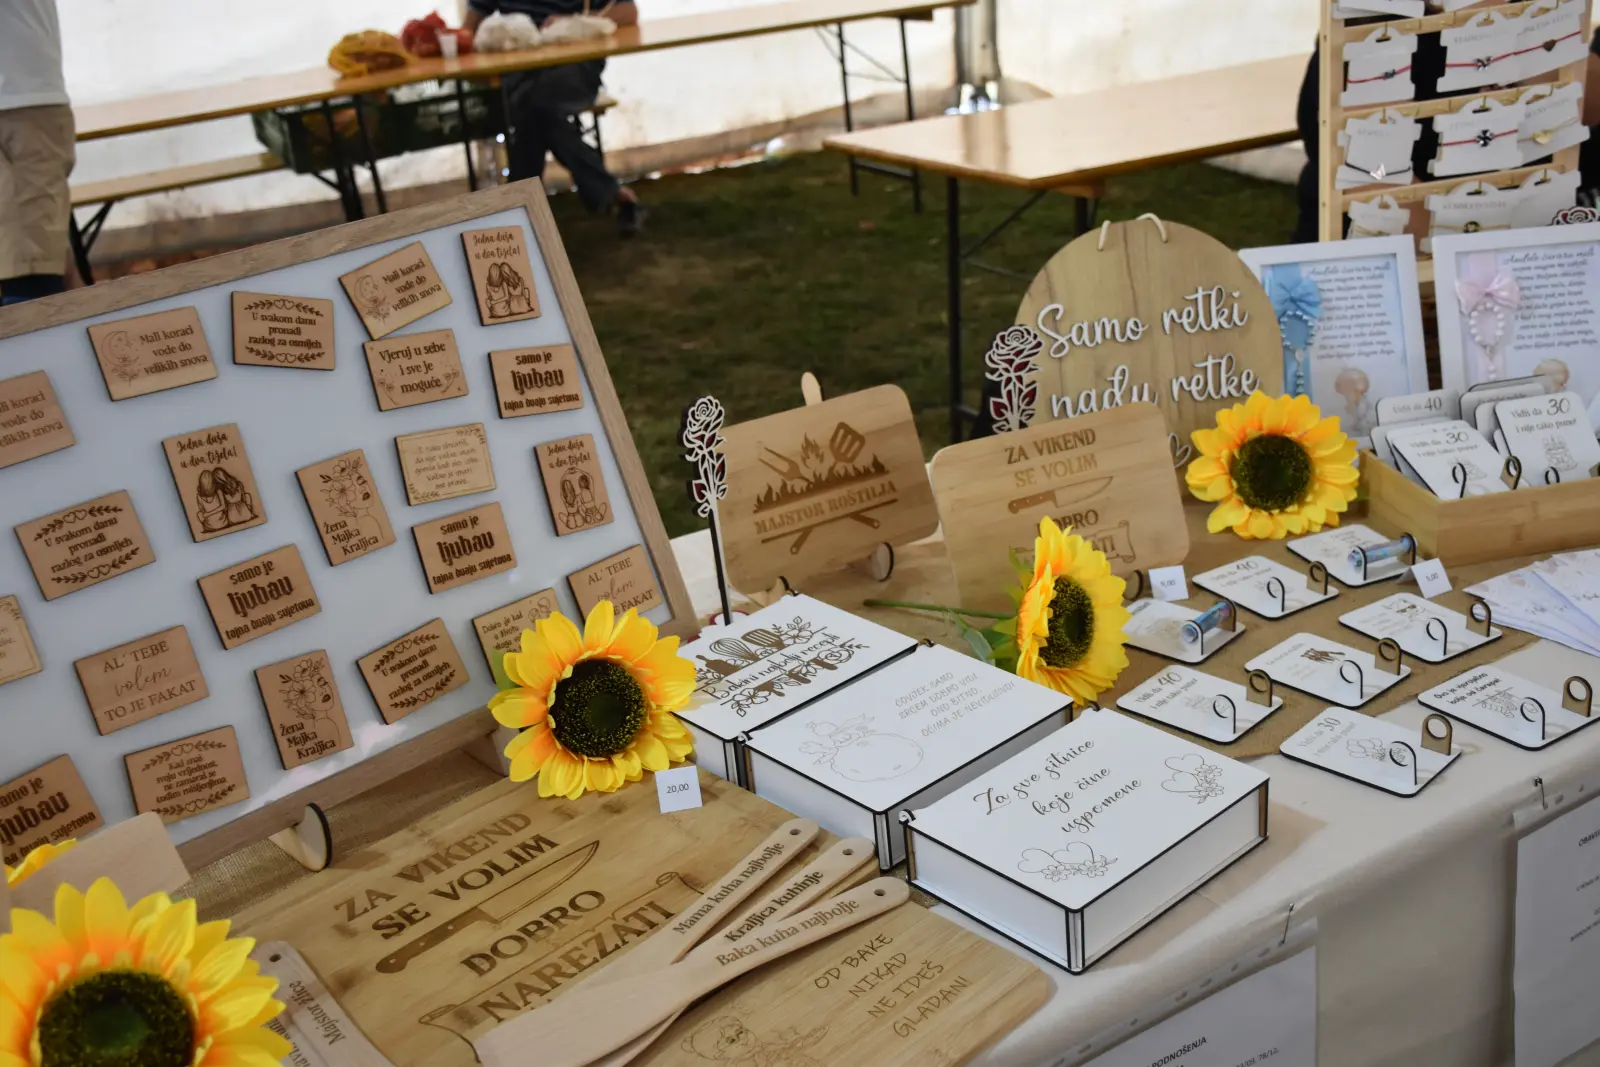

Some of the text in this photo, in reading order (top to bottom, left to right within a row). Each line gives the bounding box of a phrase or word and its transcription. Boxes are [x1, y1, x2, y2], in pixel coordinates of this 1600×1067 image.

[473, 231, 515, 246] Jedna duša
[383, 258, 426, 284] Mali koraci
[395, 274, 427, 295] vode do
[392, 283, 442, 313] velikih snova
[252, 312, 316, 326] U svakom danu
[1038, 303, 1149, 358] Samo
[1162, 285, 1248, 335] retki
[139, 325, 194, 345] Mali koraci
[248, 336, 275, 347] razlog
[288, 339, 322, 350] osmijeh
[152, 341, 191, 357] vode do
[379, 341, 446, 363] Vjeruj u sebe
[516, 351, 553, 366] samo je
[144, 354, 208, 376] velikih snova
[400, 359, 434, 376] i sve je
[1171, 352, 1260, 402] retke
[400, 377, 443, 395] moguće
[511, 367, 565, 396] ljubav
[11, 391, 45, 409] koraci
[1424, 397, 1442, 410] 40
[1546, 398, 1570, 415] 30
[1, 409, 44, 429] vode do
[32, 421, 63, 437] snova
[176, 432, 228, 453] Jedna duša
[547, 438, 586, 455] Jedna duša
[1005, 428, 1096, 465] ZA VIKEND
[1446, 431, 1469, 444] 30
[1014, 453, 1098, 488] SE VOLIM
[754, 480, 897, 535] MAJSTOR ROŠTILJA
[45, 516, 118, 548] U svakom danu
[324, 518, 347, 535] Žena
[332, 526, 360, 545] Majka
[440, 514, 479, 535] samo je
[51, 537, 133, 574] razlog za osmijeh
[342, 534, 379, 556] Kraljica
[436, 531, 496, 566] ljubav
[229, 559, 275, 585] samo je
[605, 557, 633, 575] TEBE
[1237, 559, 1258, 574] 40
[226, 575, 295, 619] ljubav
[621, 589, 654, 615] FAKAT
[130, 641, 169, 662] TEBE
[381, 643, 437, 678] U svakom danu
[702, 632, 841, 701] Bakini najbolji recepti
[113, 665, 173, 697] volem
[388, 660, 450, 700] razlog za osmijeh
[1158, 669, 1182, 690] 40
[104, 679, 197, 723] TO JE FAKAT
[279, 720, 304, 737] Žena
[1318, 714, 1341, 735] 30
[287, 730, 318, 748] Majka
[297, 738, 336, 760] Kraljica
[28, 775, 45, 792] je
[156, 773, 176, 784] svoju
[666, 782, 689, 794] 20,00
[973, 738, 1095, 816] Za sve sitnice
[1032, 766, 1111, 816] koje čine
[1061, 777, 1142, 833] uspomene
[334, 812, 532, 923] ZA VIKEND
[371, 833, 560, 940] SE VOLIM
[672, 840, 785, 935] Mama kuha najbolje
[724, 869, 824, 942] Kraljica kuhinje
[460, 890, 606, 977] DOBRO
[715, 898, 860, 967] Baka kuha najbolje
[814, 933, 894, 990] OD BAKE
[848, 951, 908, 999] NIKAD
[868, 960, 944, 1019] NE IDEŠ
[893, 975, 973, 1038] GLADAN!
[306, 997, 346, 1046] Majstor
[1151, 1036, 1207, 1067] PODNOŠENJA
